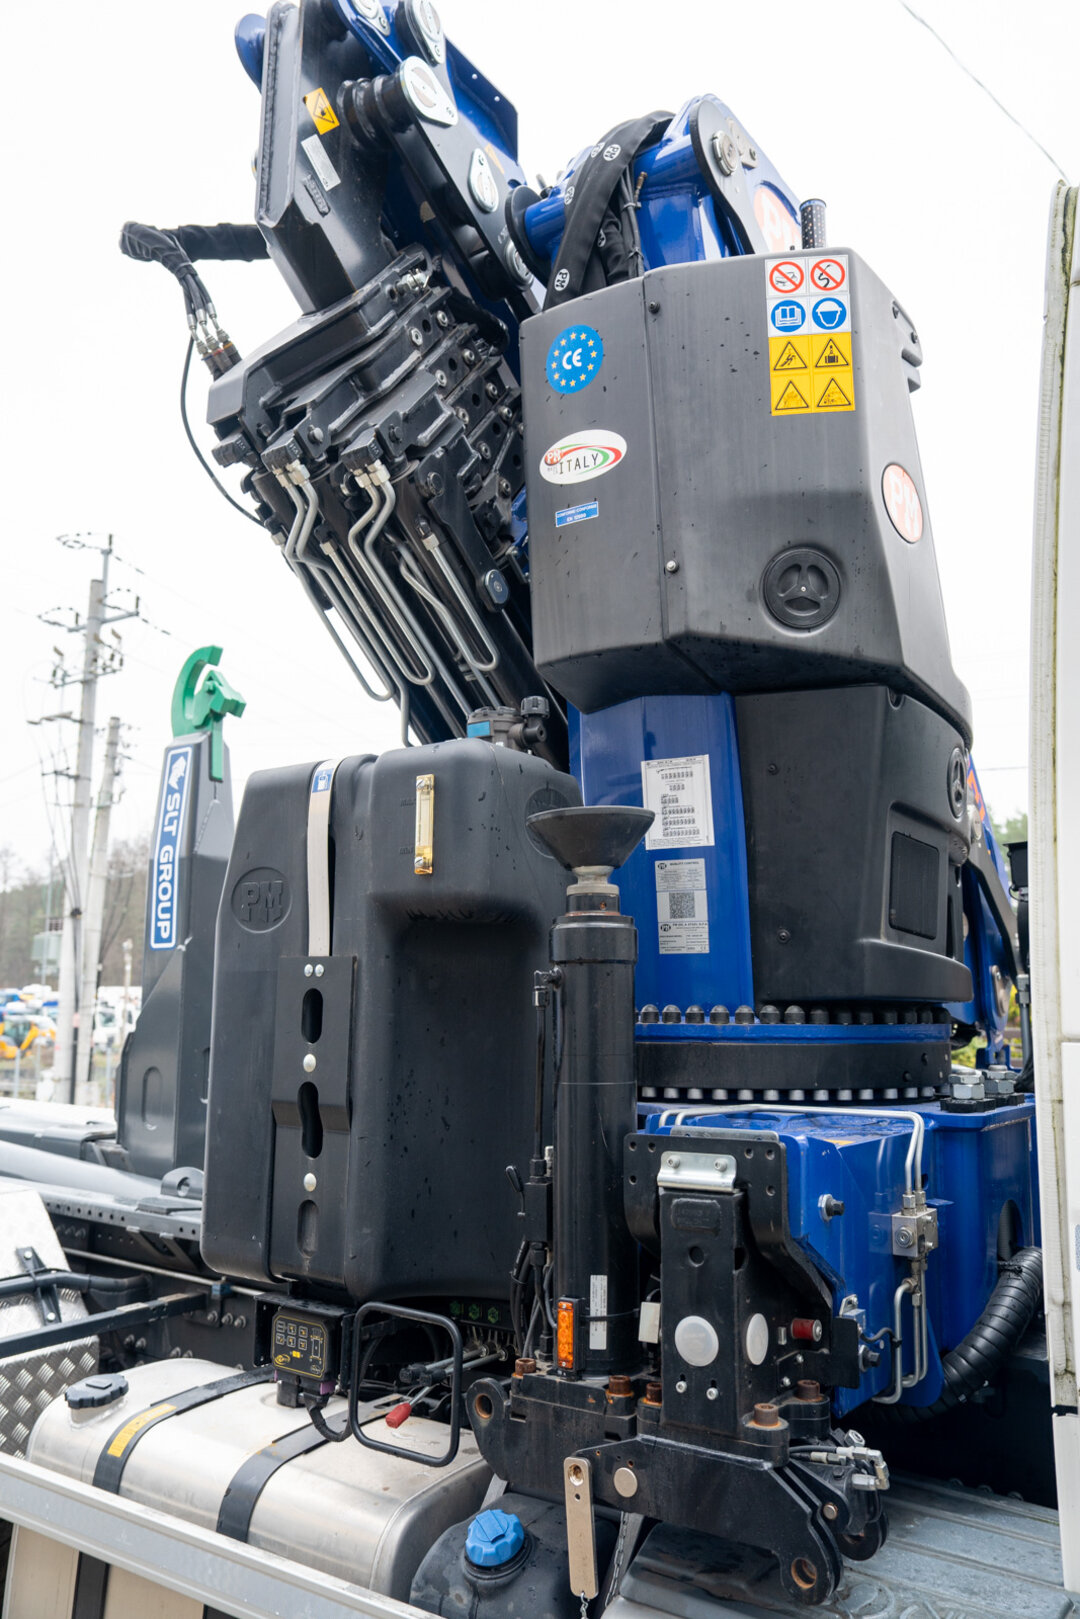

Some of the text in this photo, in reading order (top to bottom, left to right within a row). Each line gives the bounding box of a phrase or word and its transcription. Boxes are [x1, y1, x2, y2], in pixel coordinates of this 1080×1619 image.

[556, 272, 568, 288] PM
[562, 348, 582, 370] CE
[560, 453, 599, 475] ITALY
[889, 470, 920, 538] PM
[163, 792, 181, 837] SLT
[157, 845, 174, 939] GROUP
[241, 880, 284, 924] PM
